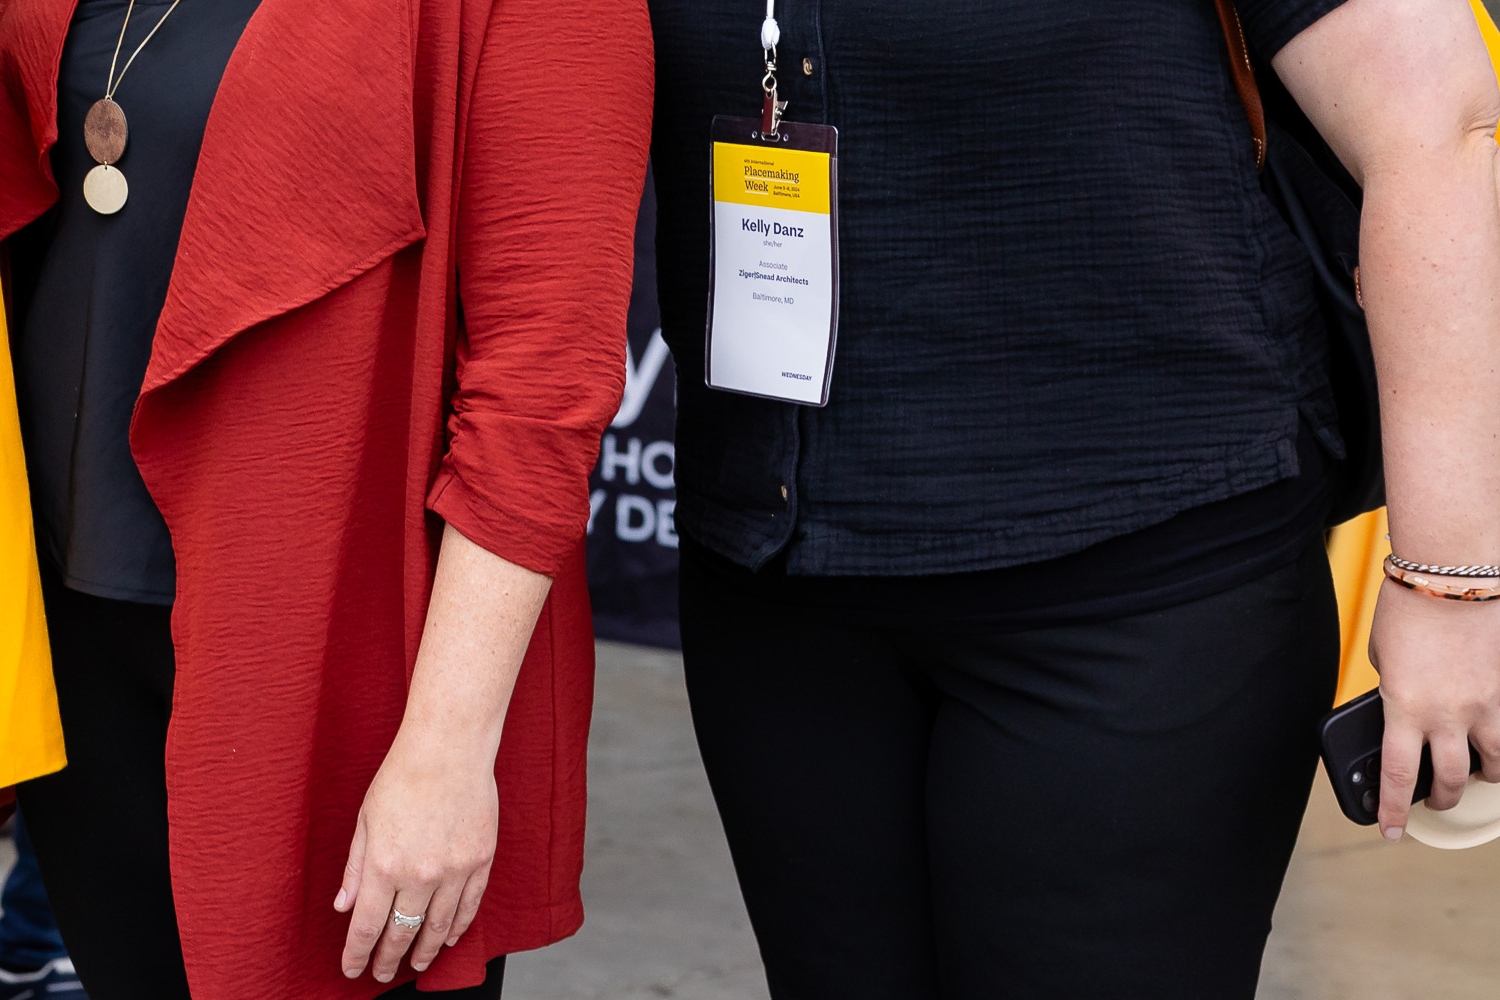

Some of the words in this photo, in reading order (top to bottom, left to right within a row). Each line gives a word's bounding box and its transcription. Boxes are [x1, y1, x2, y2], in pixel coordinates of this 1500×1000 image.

[744, 166, 800, 183] Placemaking
[745, 180, 769, 192] Week
[742, 218, 771, 237] Kelly
[773, 222, 804, 238] Danz
[763, 240, 783, 248] she/her
[758, 260, 788, 271] Associate
[776, 275, 809, 286] Architects
[752, 292, 783, 304] Baltimore,
[781, 371, 812, 381] WEDNESDAY
